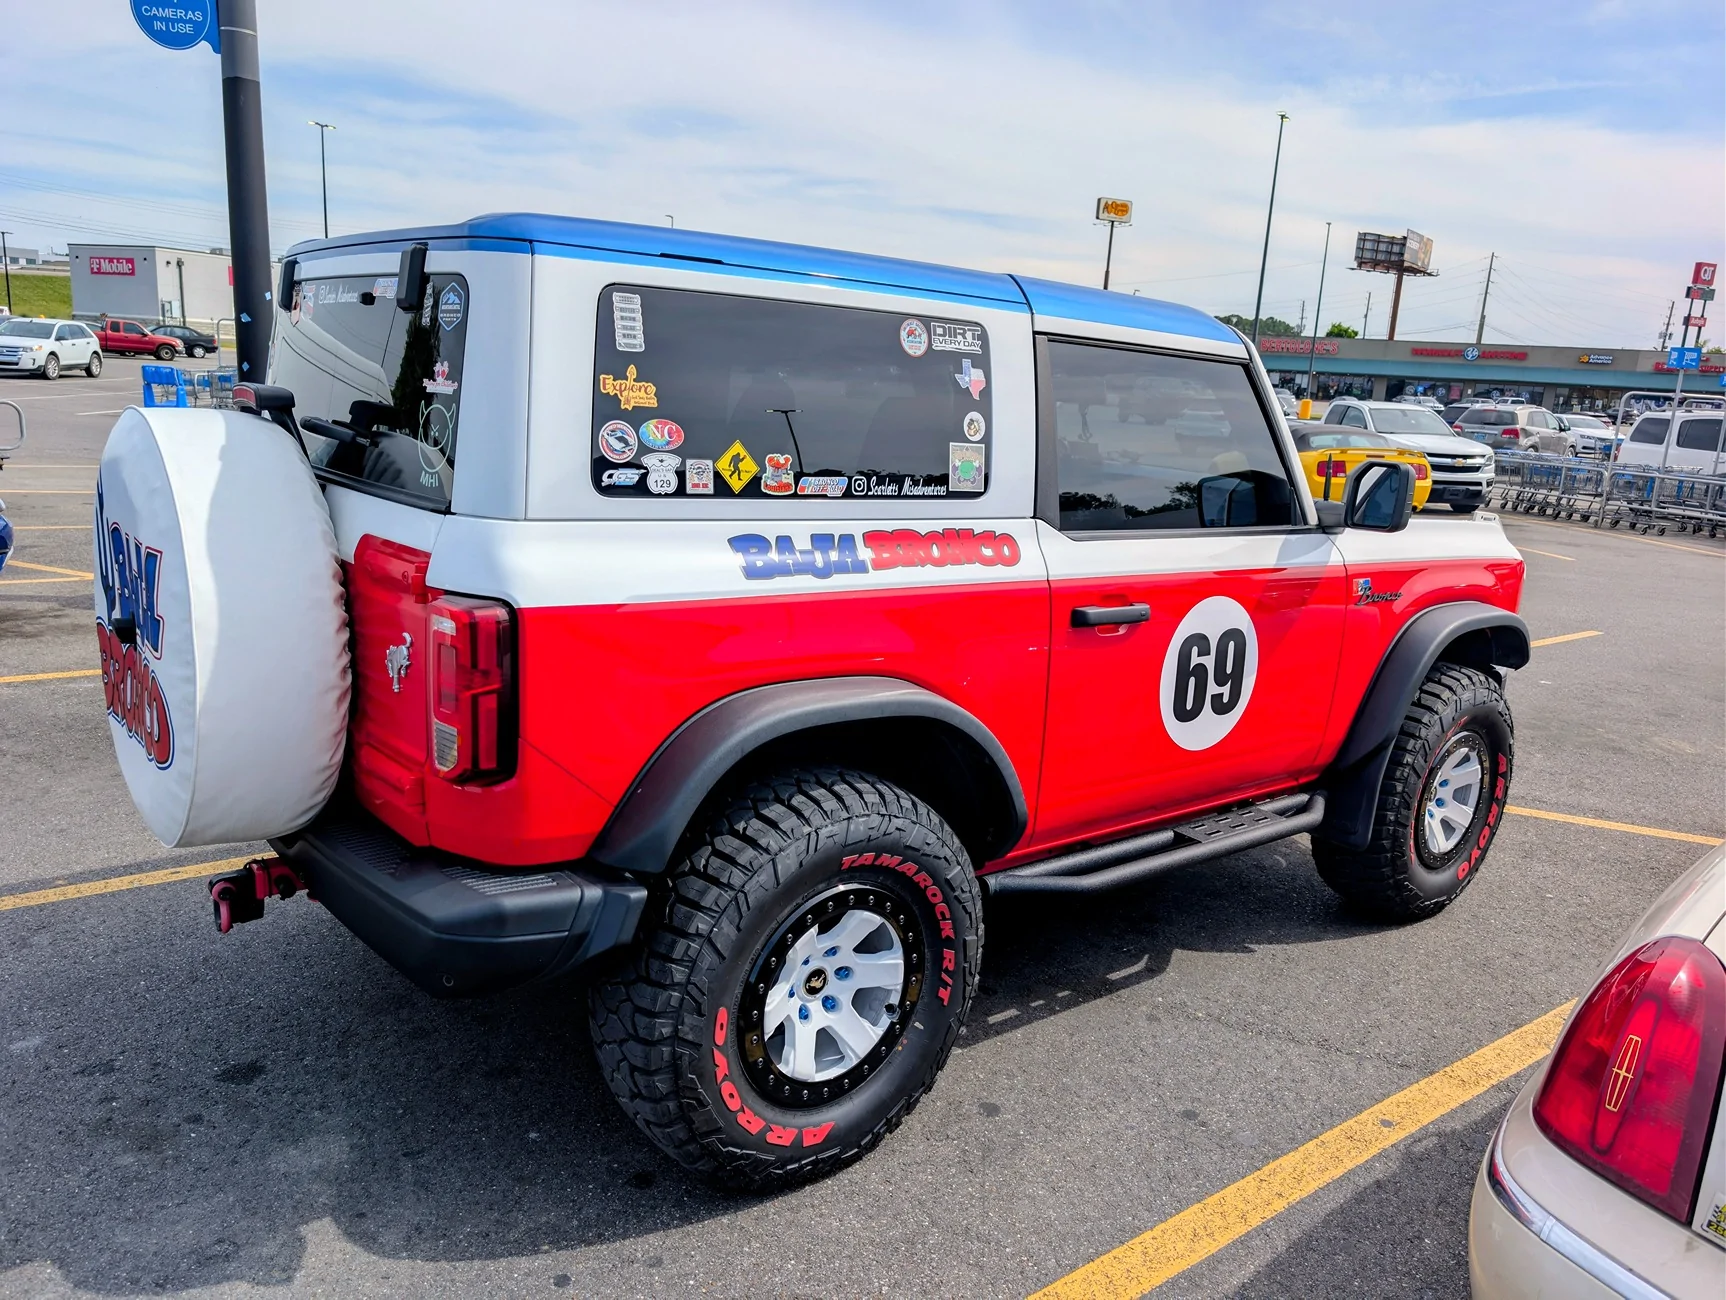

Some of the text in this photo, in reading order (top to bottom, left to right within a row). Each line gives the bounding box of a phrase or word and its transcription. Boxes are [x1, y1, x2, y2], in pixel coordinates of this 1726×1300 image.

[142, 5, 203, 21] CAMERAS
[153, 20, 194, 34] IN USE
[1700, 266, 1714, 281] QT
[932, 323, 981, 341] DIRT
[933, 337, 981, 349] EVERY DAY
[601, 374, 655, 397] Explore
[649, 424, 677, 441] NC
[420, 470, 439, 487] MHI
[654, 480, 671, 488] 129
[868, 476, 947, 496] Scarletts Misadventures
[727, 528, 1021, 580] BAJA BRONCO
[1354, 586, 1403, 606] Bronco
[1173, 627, 1247, 723] 69
[1457, 753, 1507, 880] ARROYO
[841, 852, 955, 1006] TAMAROCK R/T
[713, 1006, 836, 1147] ARROYO
